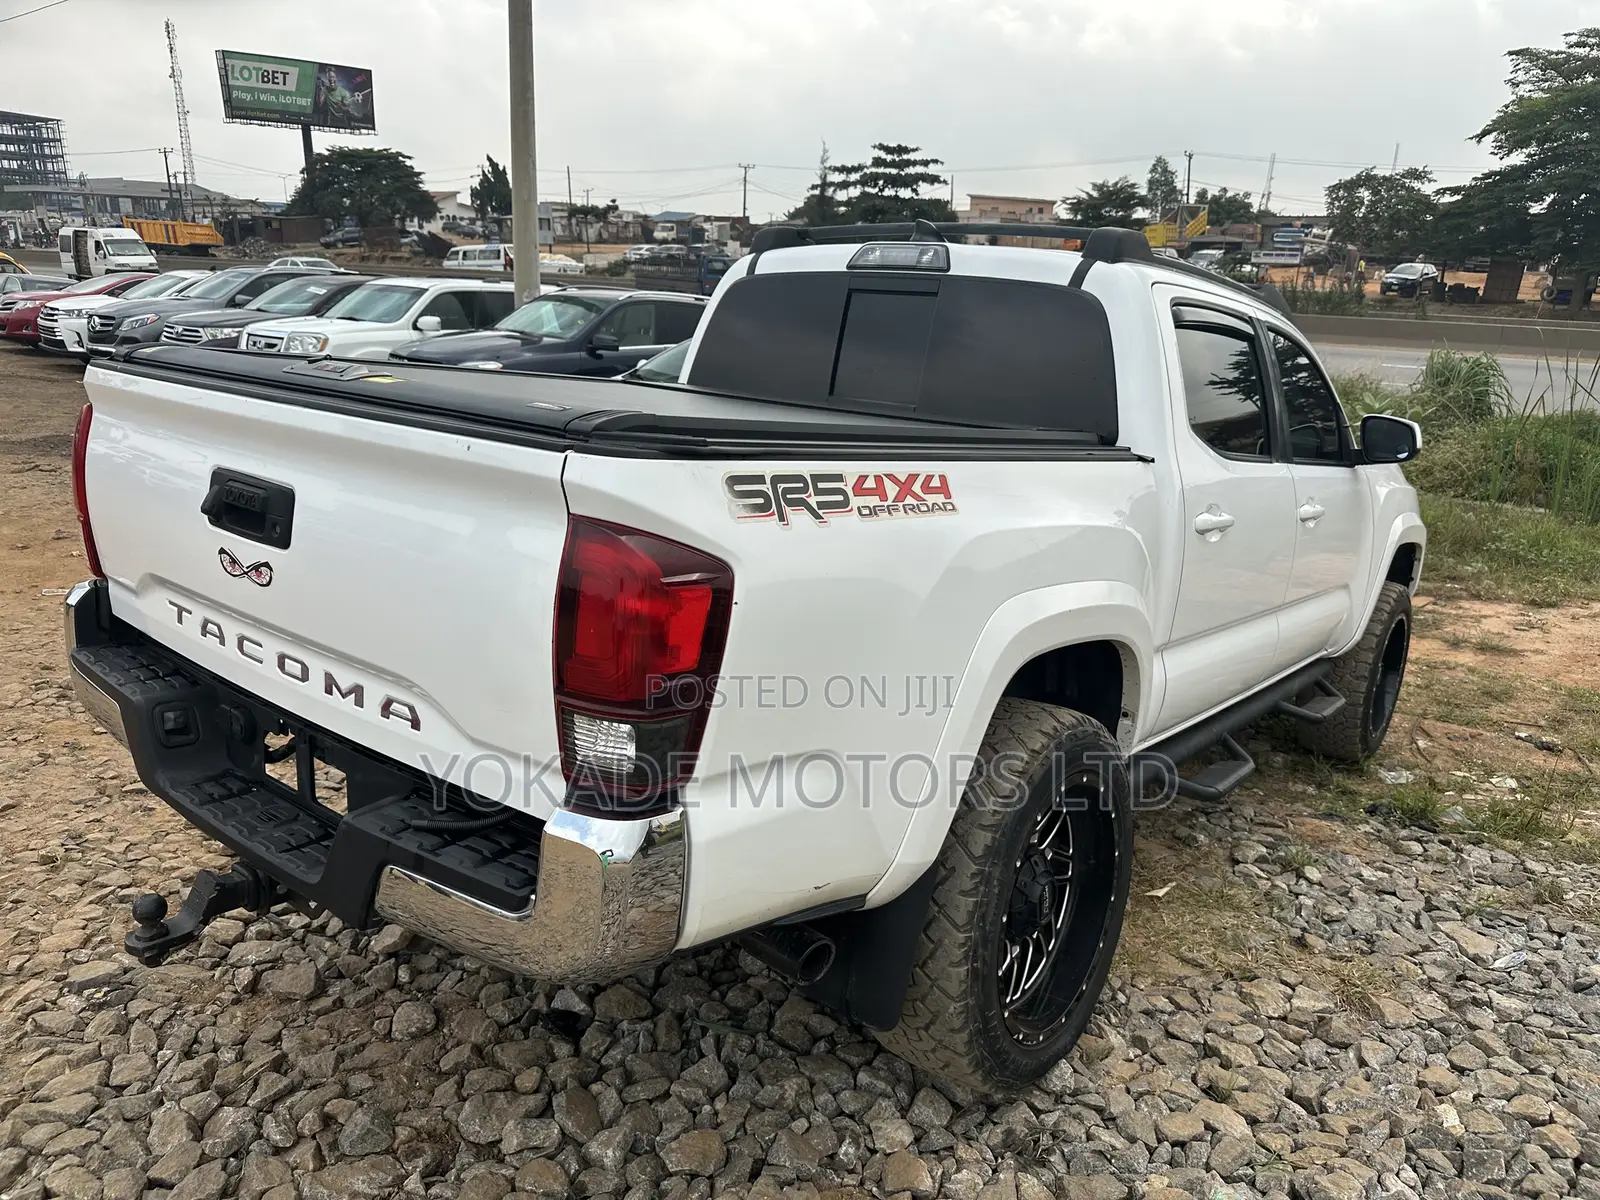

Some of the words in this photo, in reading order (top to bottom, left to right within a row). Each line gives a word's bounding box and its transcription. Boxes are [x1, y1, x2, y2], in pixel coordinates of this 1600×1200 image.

[232, 90, 254, 102] Play,
[260, 93, 278, 103] Win,
[279, 94, 312, 106] iLOTBET
[224, 486, 260, 511] TOYOTA
[725, 474, 851, 525] SR5
[857, 505, 902, 518] OFF
[903, 503, 956, 516] ROAD
[166, 599, 422, 732] TACOMA
